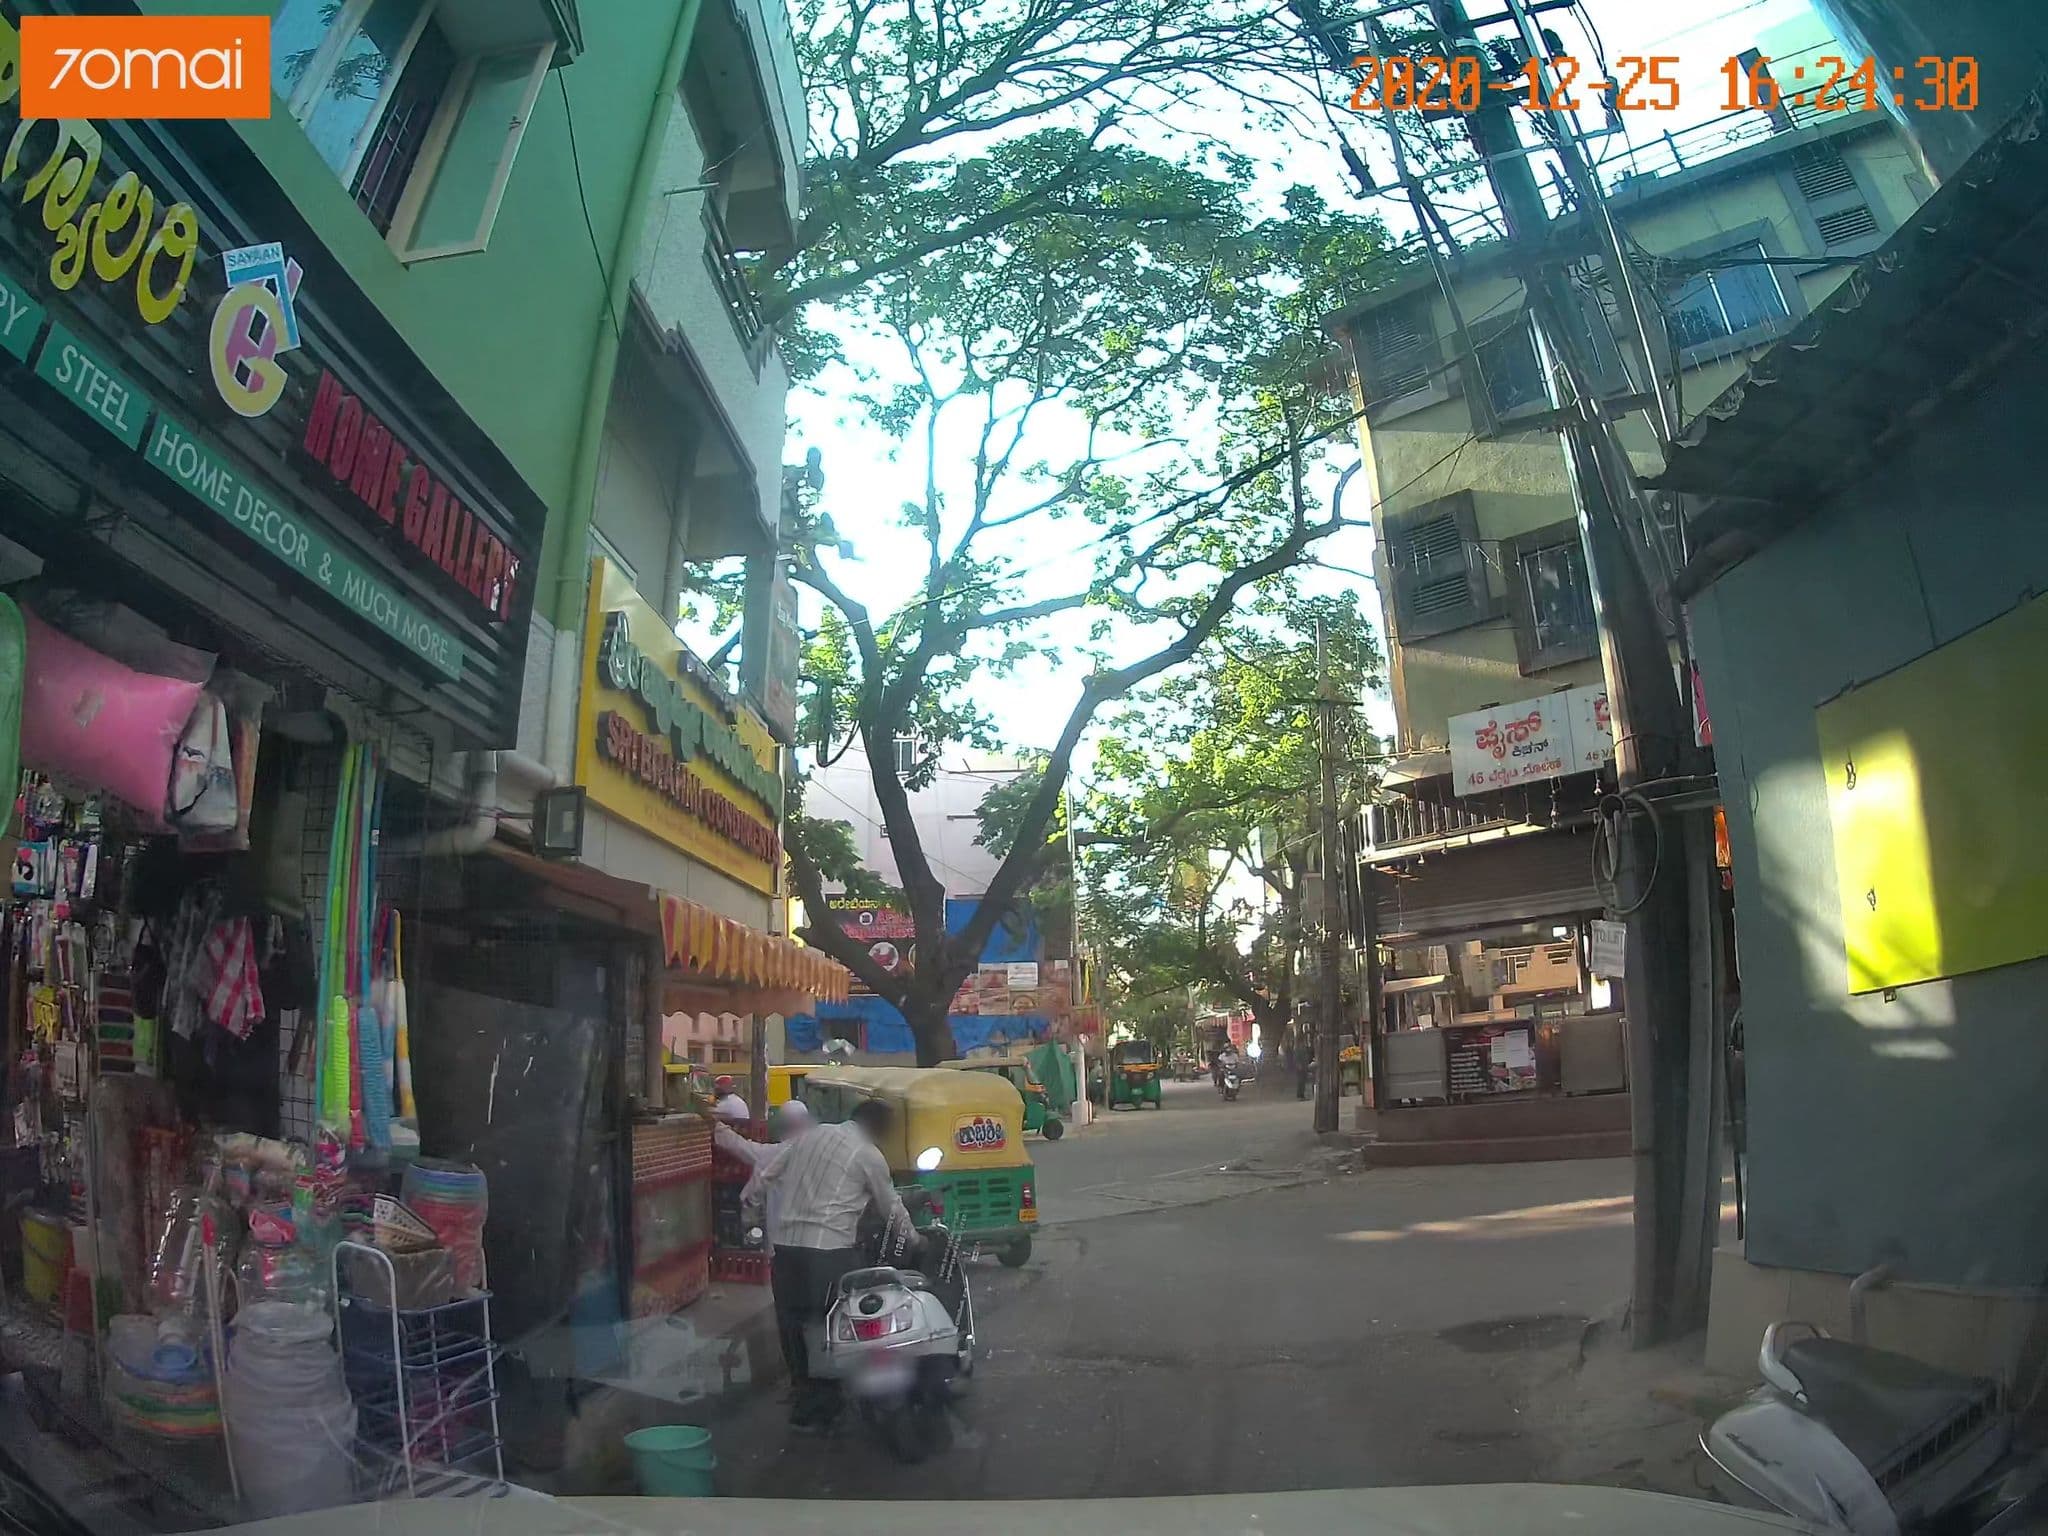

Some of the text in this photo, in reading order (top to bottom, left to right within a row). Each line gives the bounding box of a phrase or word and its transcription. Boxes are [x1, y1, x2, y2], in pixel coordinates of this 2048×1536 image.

[55, 344, 129, 433] STEEL
[154, 425, 231, 507] HOME
[234, 483, 309, 568] DECOR
[317, 553, 332, 586] &
[341, 569, 399, 633] MUCH
[304, 368, 520, 622] HOME GALLERY
